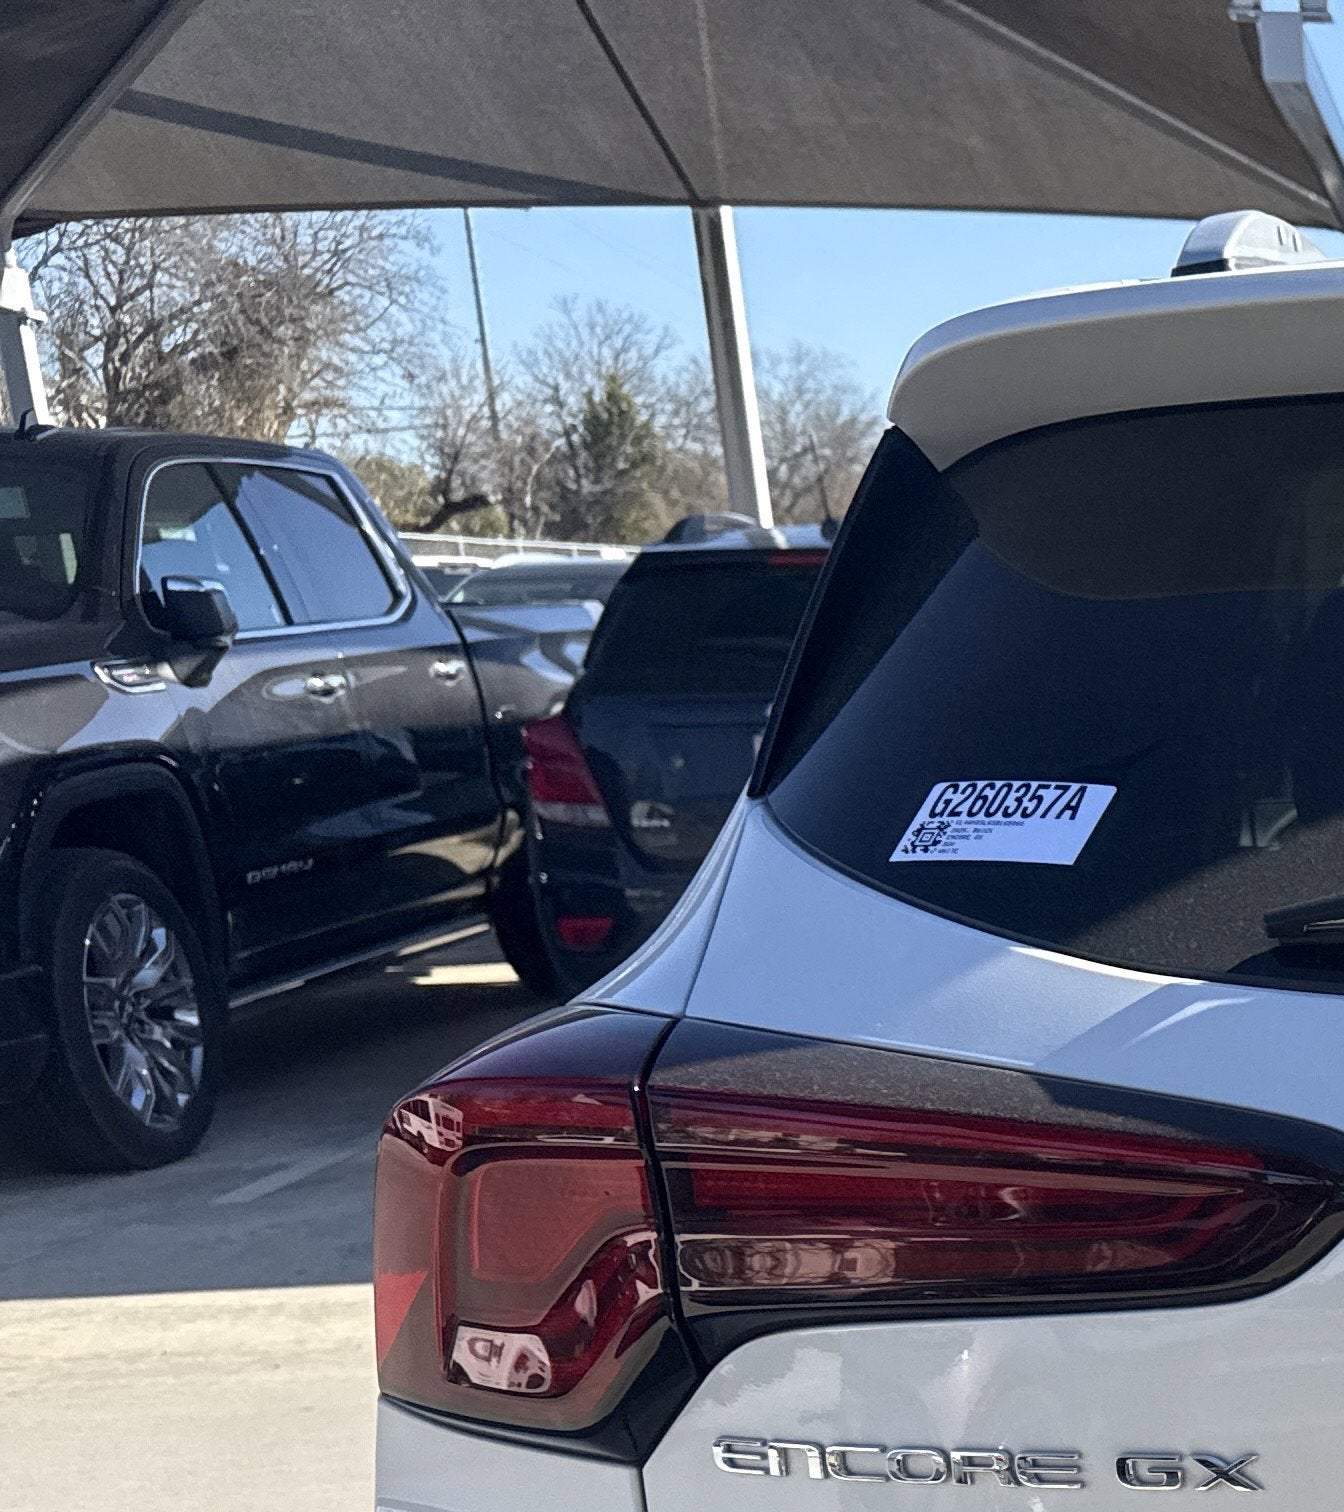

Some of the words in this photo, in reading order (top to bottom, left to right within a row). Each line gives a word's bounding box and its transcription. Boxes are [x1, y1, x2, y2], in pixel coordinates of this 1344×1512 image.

[929, 782, 1089, 821] G260357A
[712, 1435, 1086, 1489] ENCORE
[1115, 1450, 1265, 1493] GX
